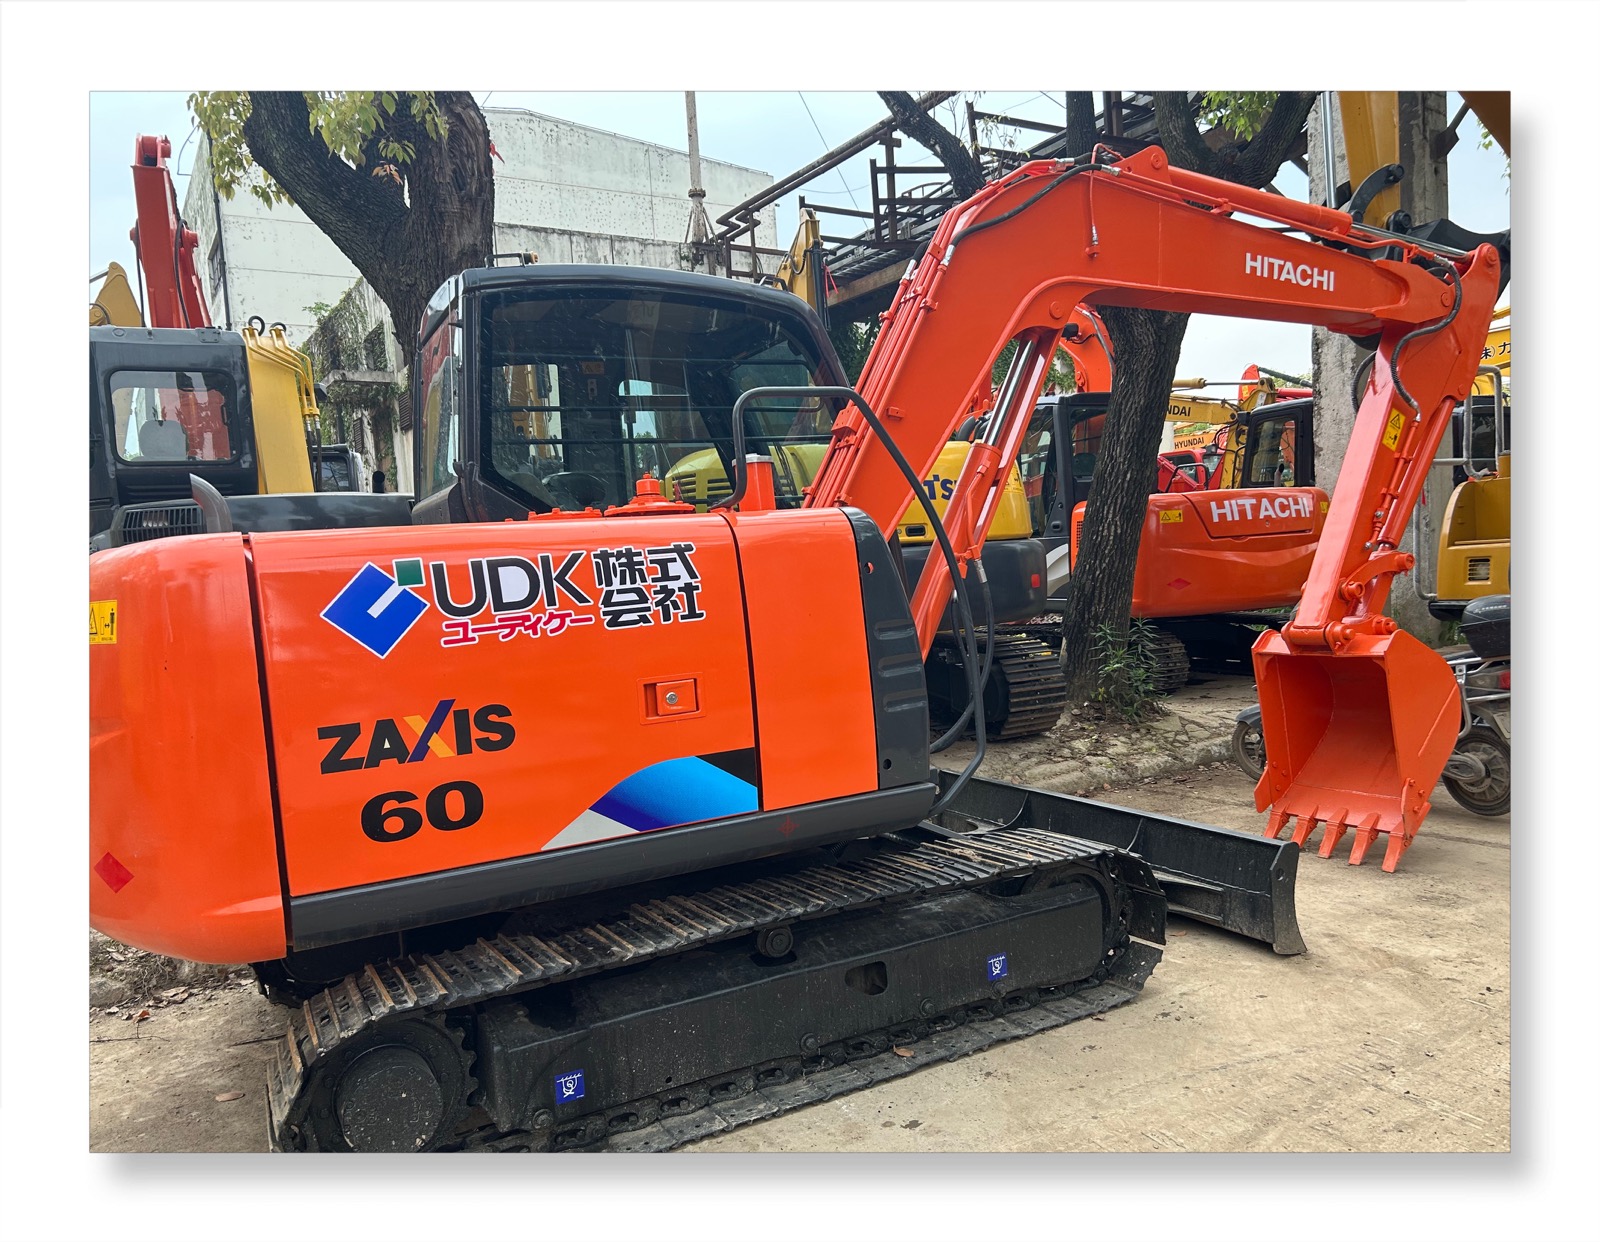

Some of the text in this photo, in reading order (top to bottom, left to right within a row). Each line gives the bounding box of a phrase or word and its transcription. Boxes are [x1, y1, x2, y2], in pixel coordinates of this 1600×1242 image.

[1245, 252, 1335, 292] HITACHI
[1174, 436, 1205, 450] HYUNDAI
[1210, 497, 1310, 523] HITACHI
[430, 550, 593, 619] UDK
[443, 611, 594, 647] ユーディケー
[317, 699, 516, 775] ZAXIS
[360, 780, 484, 843] 60
